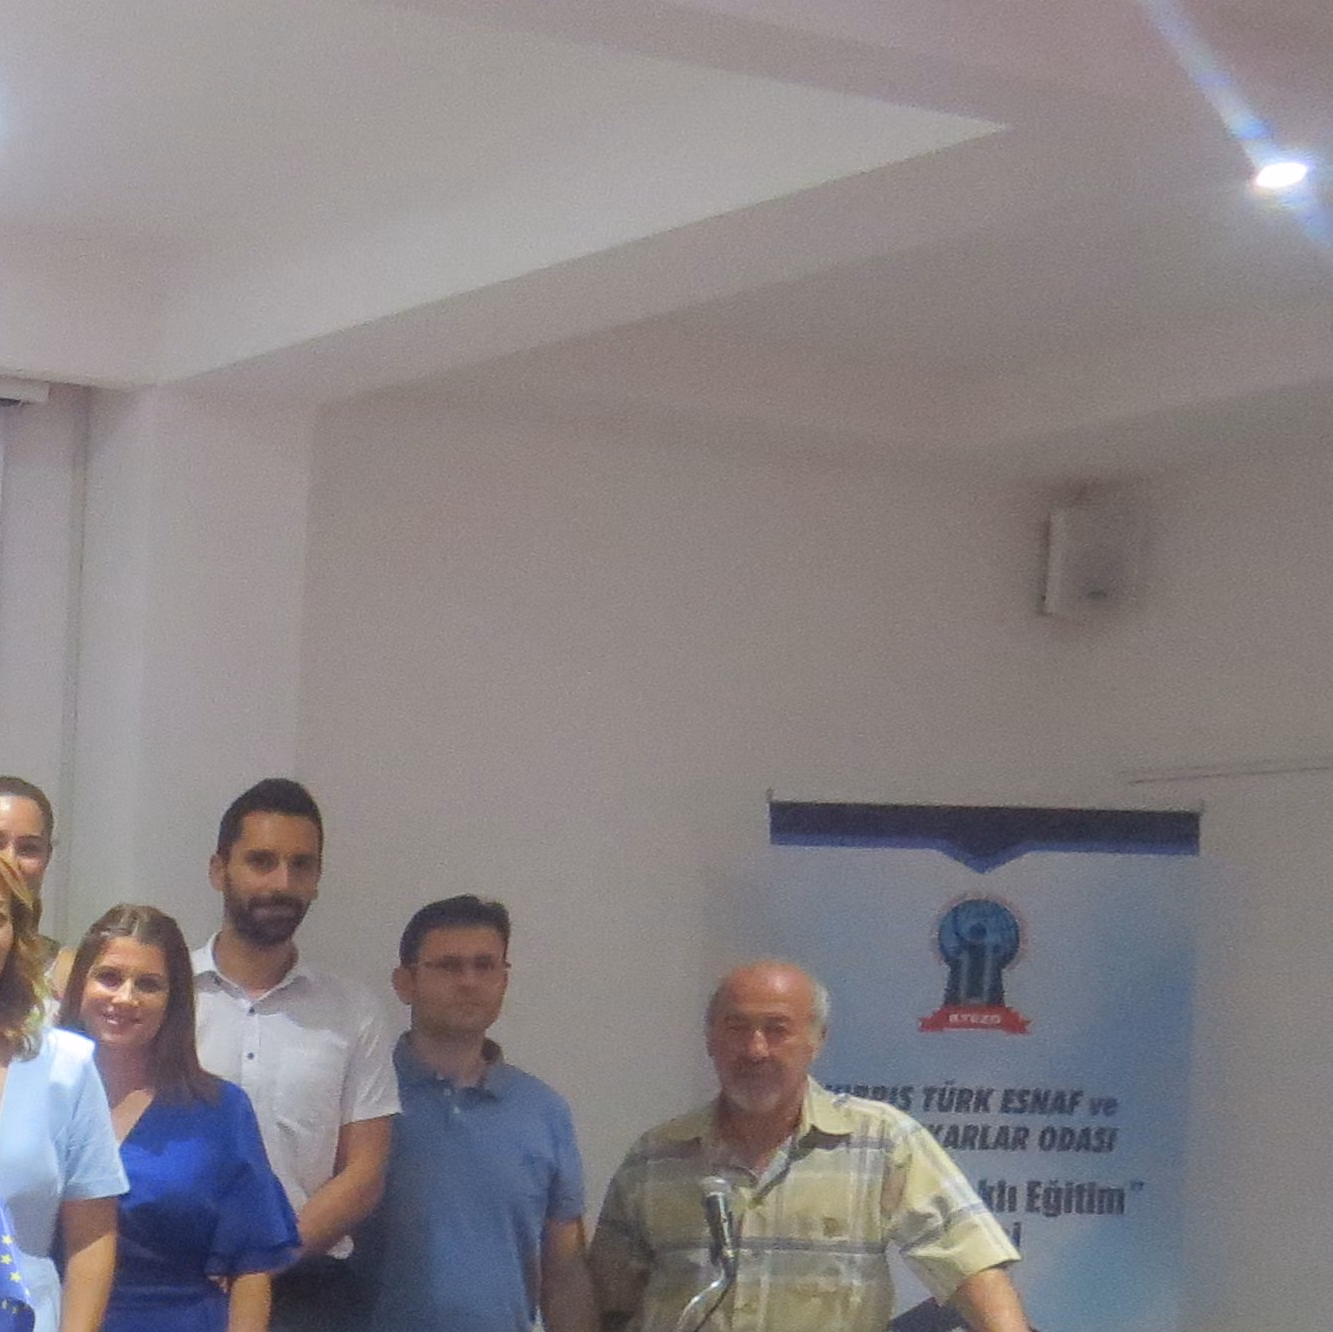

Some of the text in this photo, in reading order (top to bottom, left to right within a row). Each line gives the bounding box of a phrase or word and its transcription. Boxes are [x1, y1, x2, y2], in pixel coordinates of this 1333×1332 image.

[922, 1079, 997, 1113] TÜRK
[999, 1088, 1084, 1115] ESNAF
[1089, 1097, 1119, 1116] ve
[1038, 1126, 1120, 1153] ODASI
